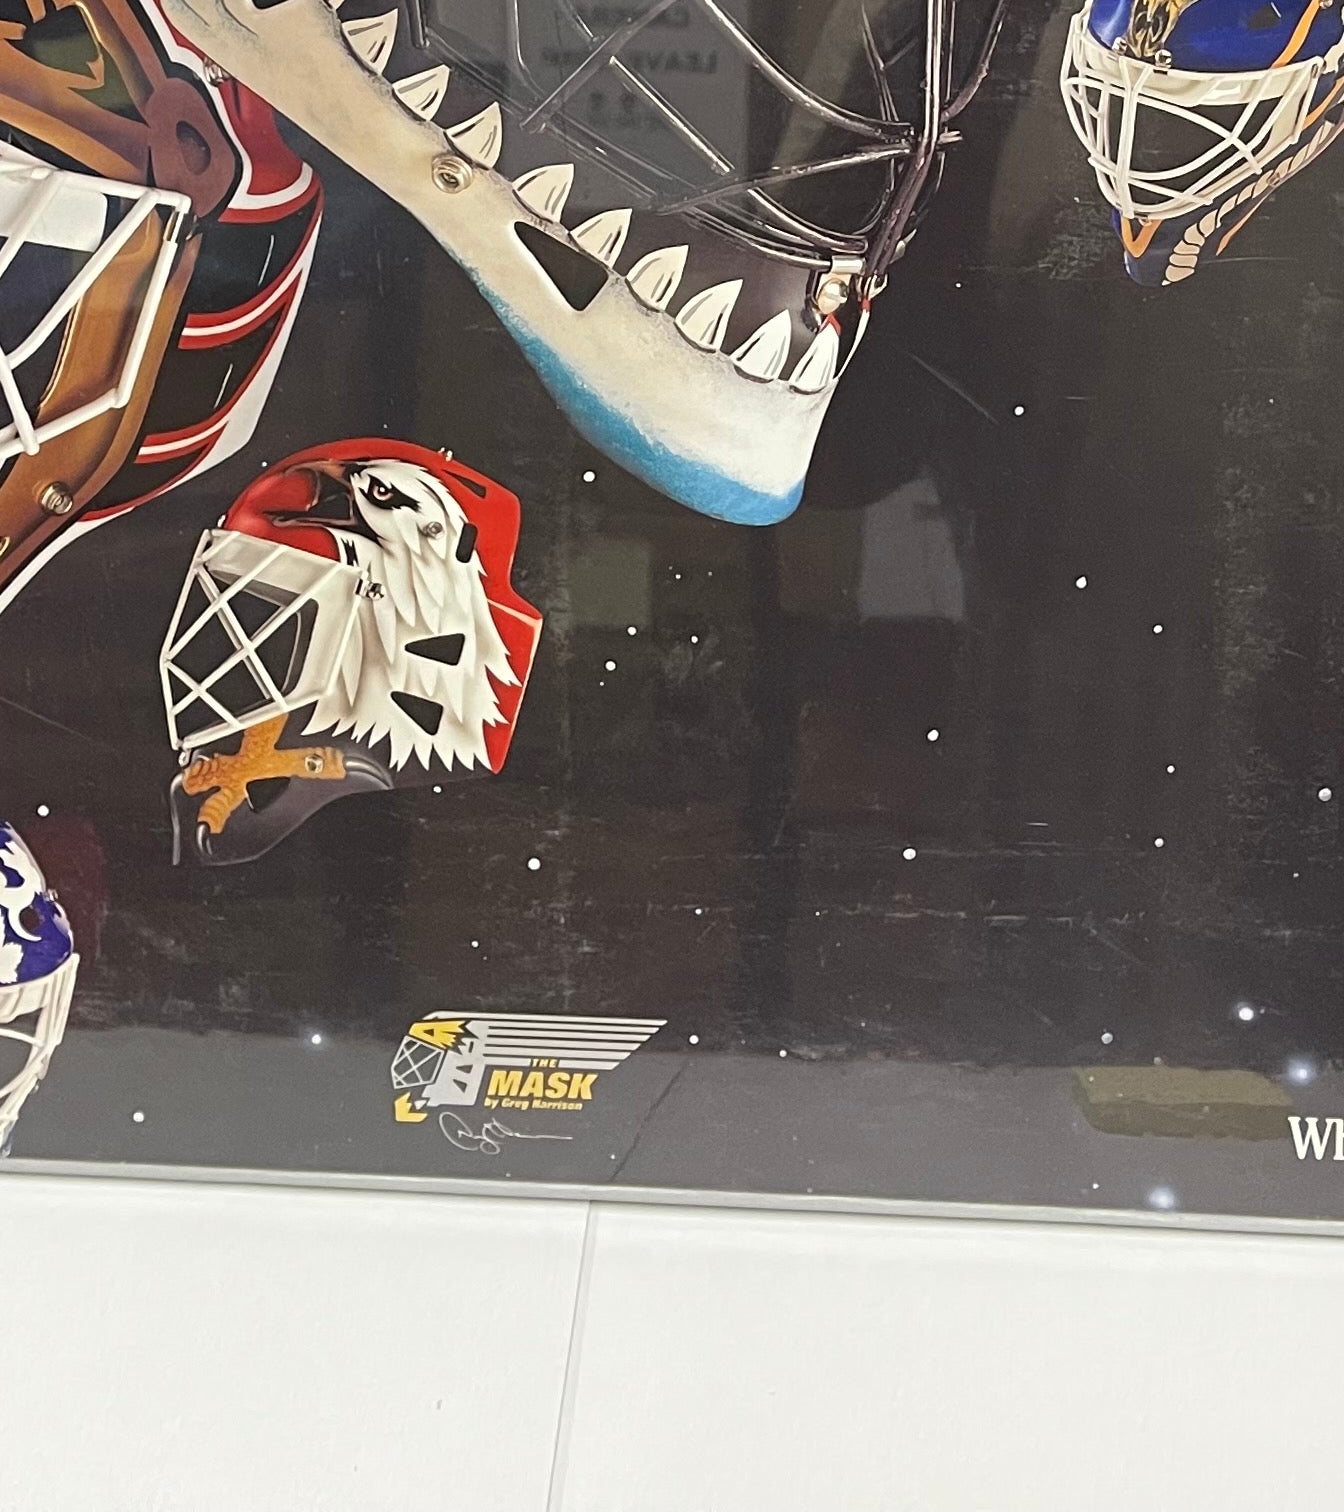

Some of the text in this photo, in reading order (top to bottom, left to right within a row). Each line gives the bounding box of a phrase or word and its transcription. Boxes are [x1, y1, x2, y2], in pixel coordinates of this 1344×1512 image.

[531, 1058, 558, 1069] THE
[487, 1069, 599, 1100] MASK
[483, 1097, 584, 1111] by Greg Harrison
